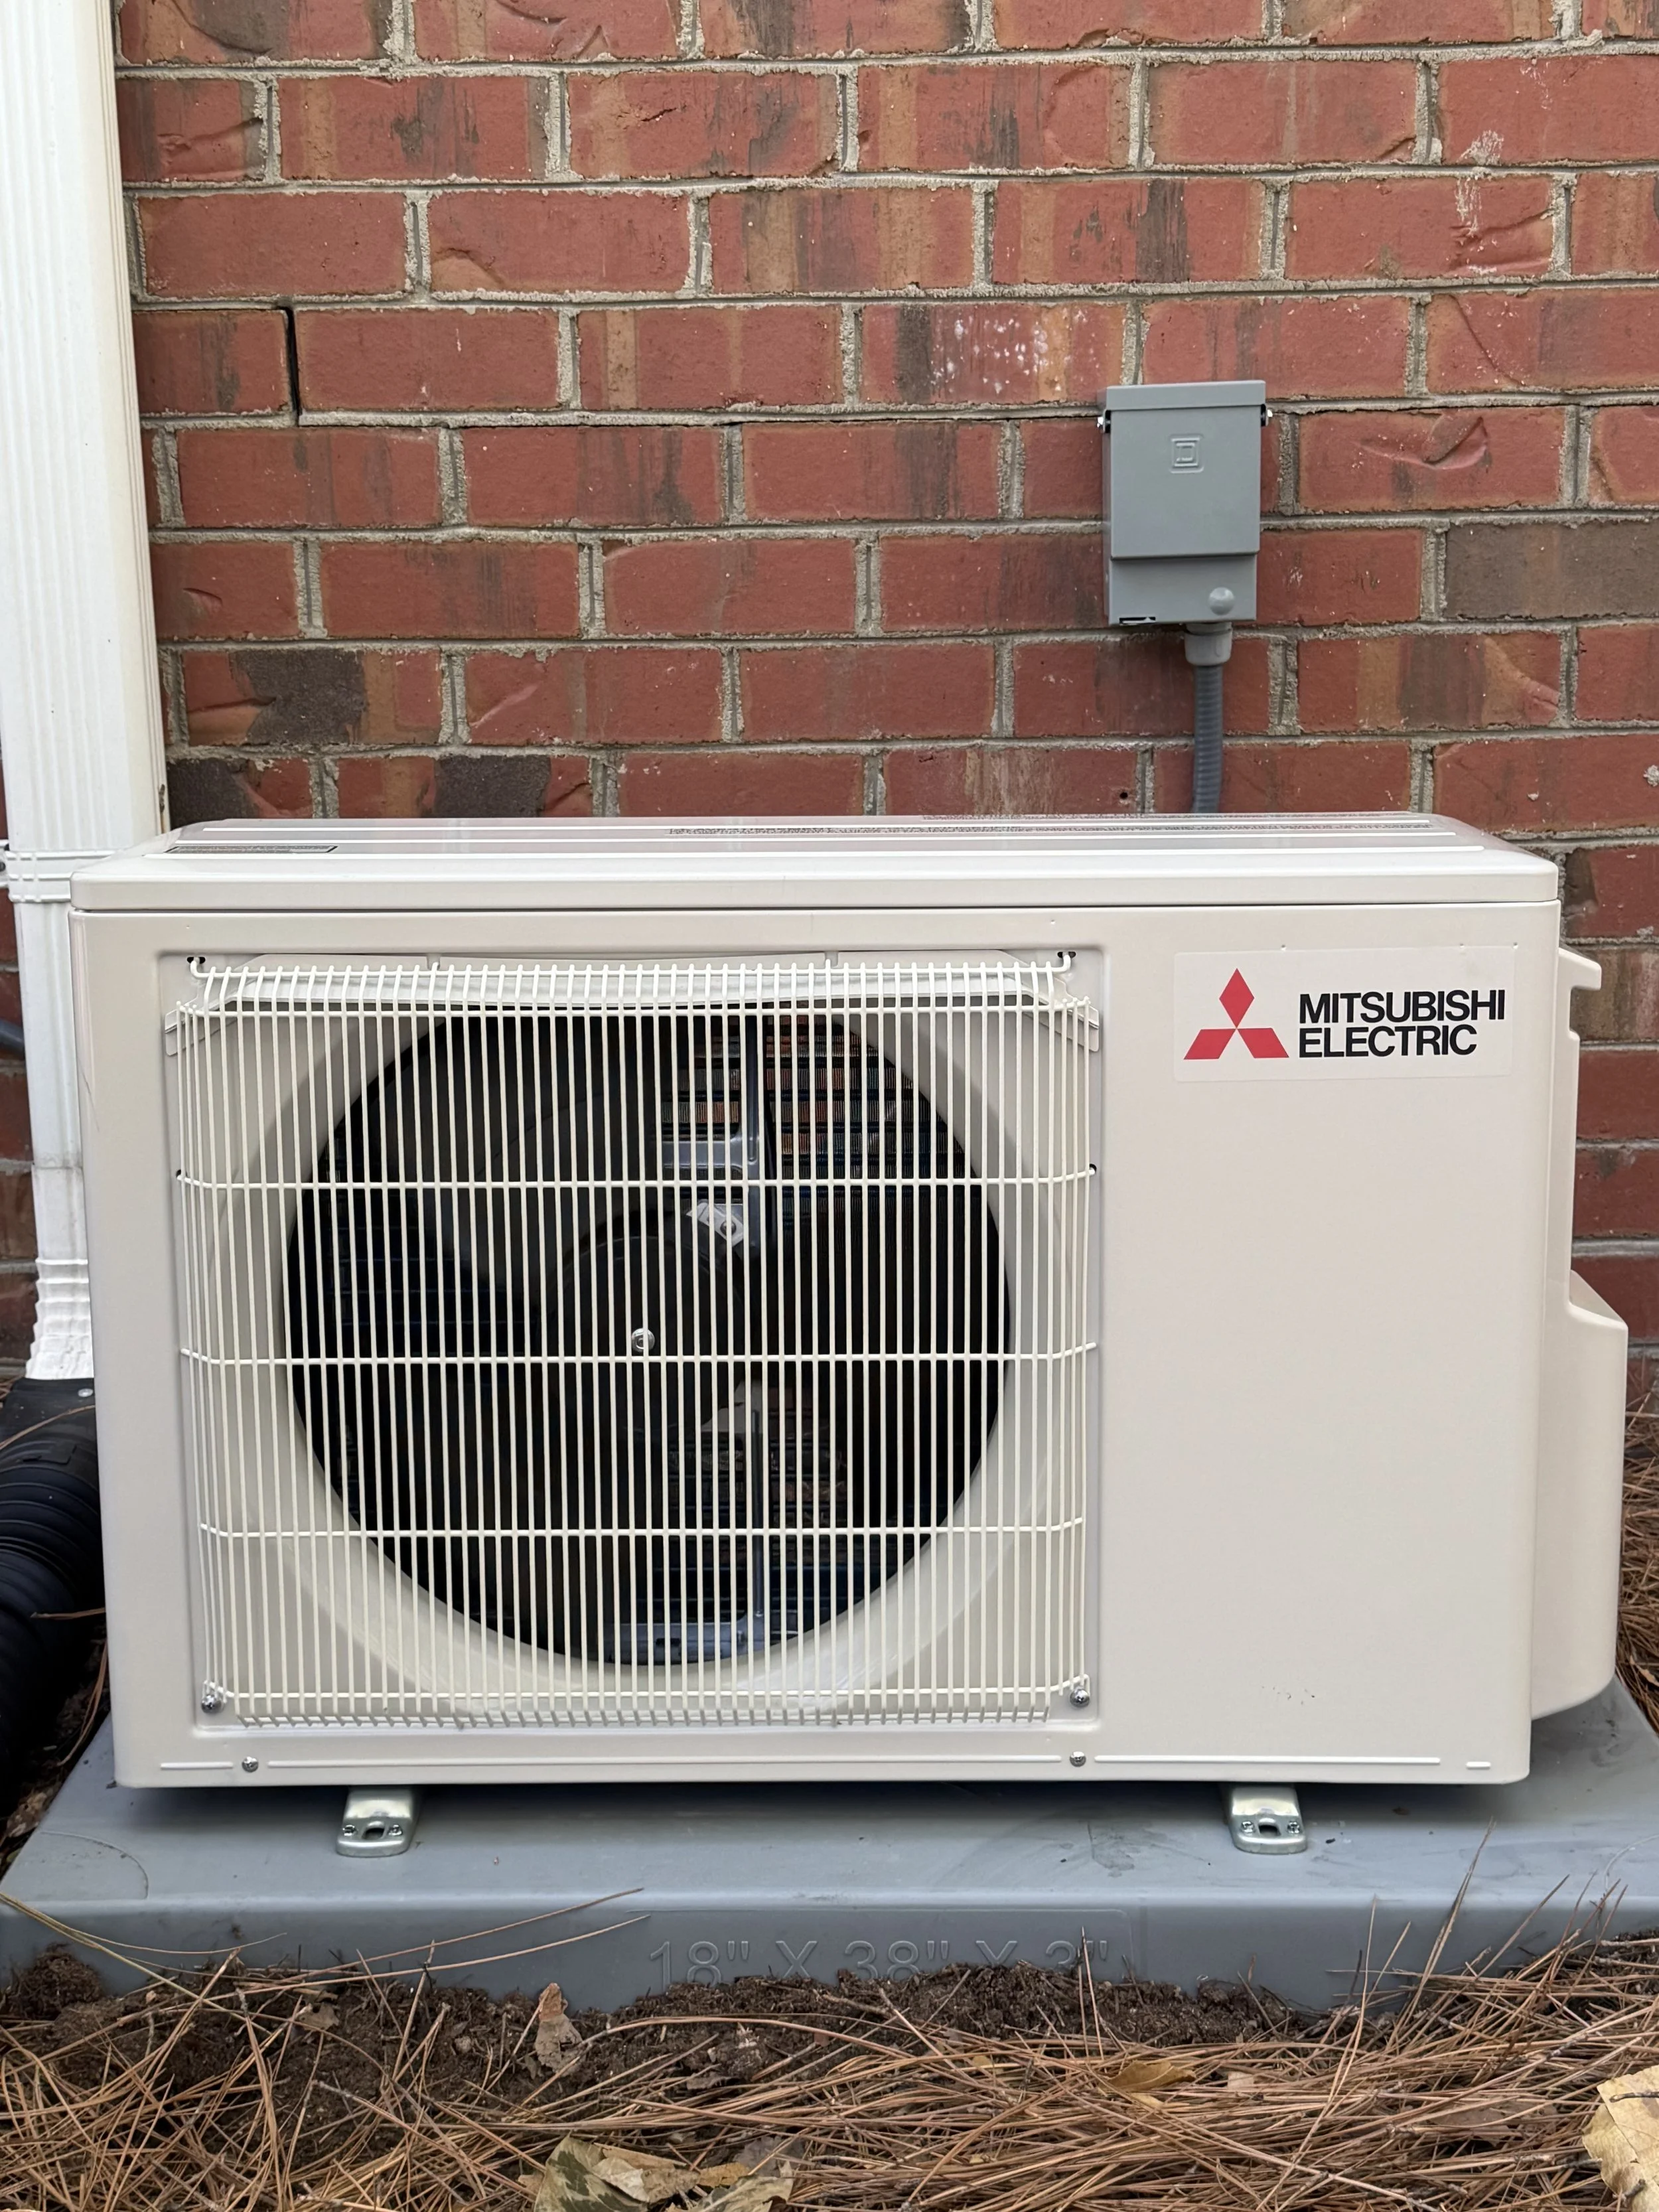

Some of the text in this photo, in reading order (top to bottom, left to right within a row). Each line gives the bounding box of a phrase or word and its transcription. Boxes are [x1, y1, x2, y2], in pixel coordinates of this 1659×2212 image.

[1299, 990, 1505, 1024] MITSUBISHI
[1299, 1024, 1477, 1058] ELECTRIC
[650, 1940, 749, 1989] 18"
[775, 1940, 818, 1978] X
[844, 1940, 949, 1981] 38"
